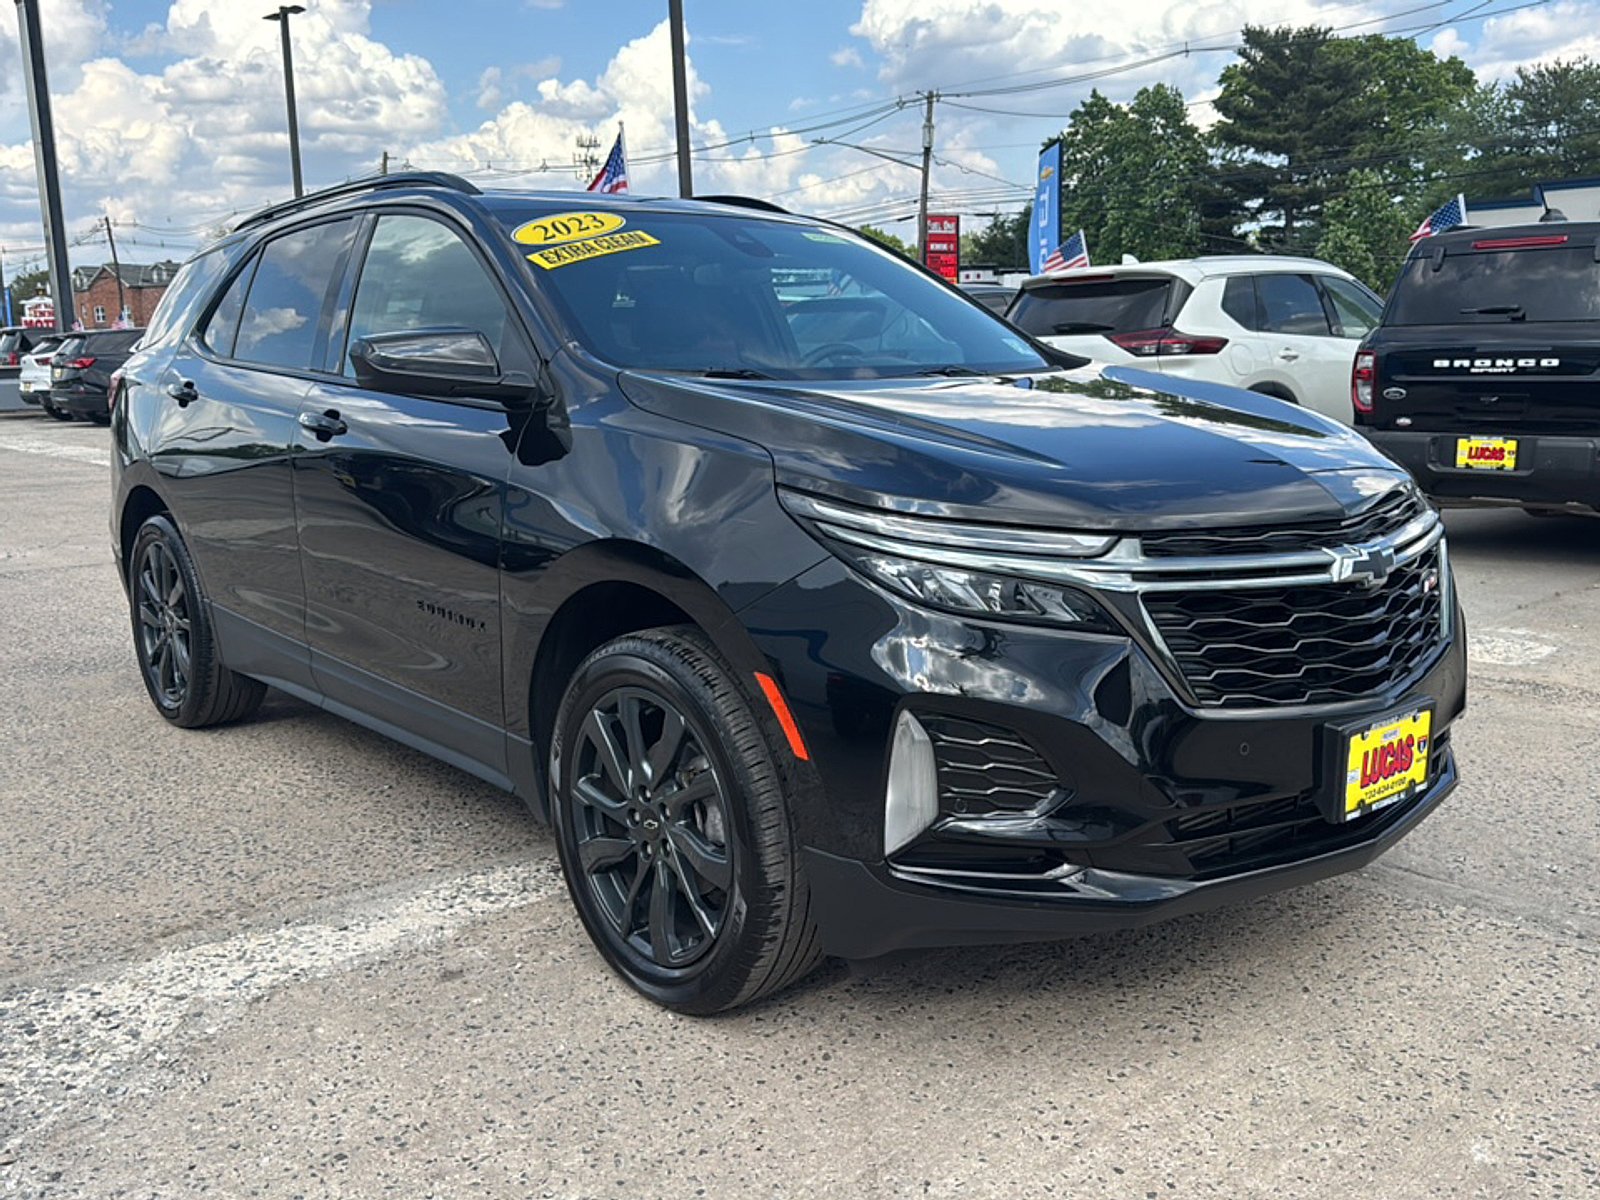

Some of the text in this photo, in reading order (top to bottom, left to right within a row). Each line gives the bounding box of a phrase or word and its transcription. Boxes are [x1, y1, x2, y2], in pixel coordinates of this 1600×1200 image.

[533, 213, 605, 241] 2023
[539, 233, 647, 265] EXTRA CLEAN
[1433, 358, 1560, 368] BRONCO
[1467, 446, 1505, 461] LUCAS
[1360, 734, 1415, 789] LUCAS
